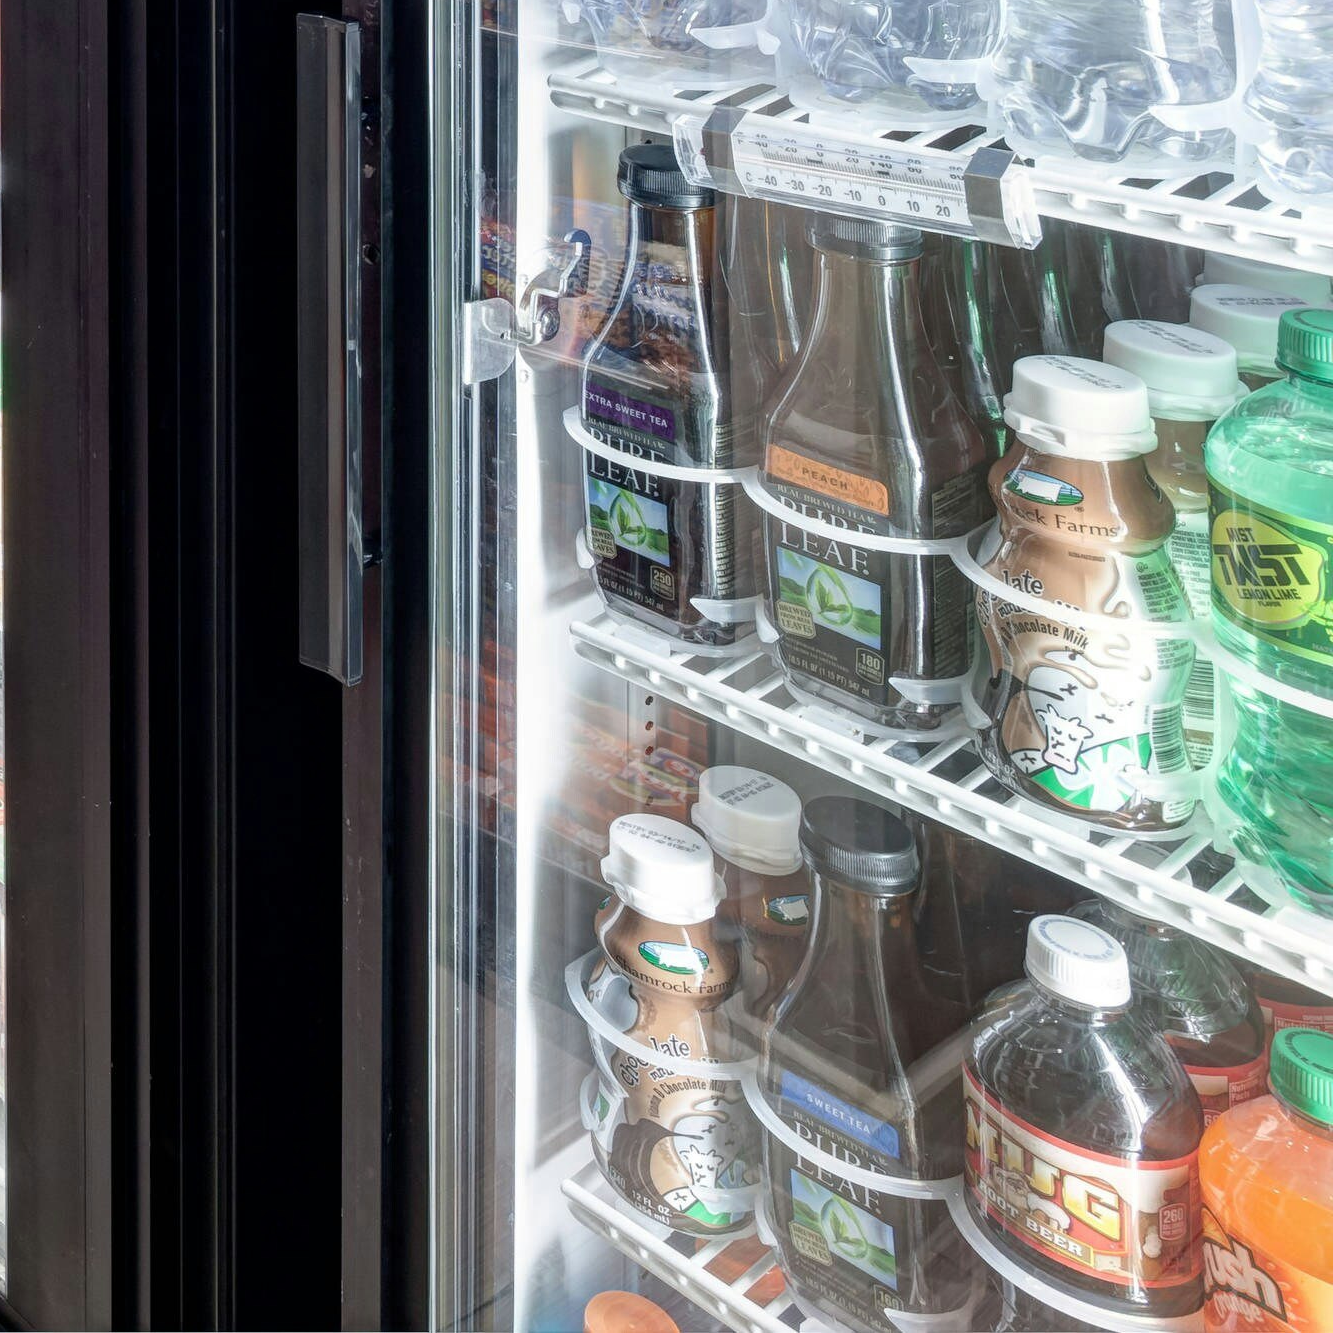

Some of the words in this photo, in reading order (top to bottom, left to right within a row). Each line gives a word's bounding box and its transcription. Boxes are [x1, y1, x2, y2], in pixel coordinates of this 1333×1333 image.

[758, 175, 777, 186] -40
[785, 179, 805, 192] -30
[812, 184, 832, 197] -20
[843, 189, 862, 202] -10
[878, 195, 886, 206] 0
[907, 199, 920, 213] 10
[935, 204, 951, 218] 20
[583, 392, 612, 408] EXTRA
[615, 403, 647, 421] SWEET
[649, 415, 668, 428] TEA
[802, 467, 848, 491] PEACH
[777, 484, 800, 499] REAL
[1054, 513, 1119, 537] Farms
[1226, 527, 1255, 544] MIST
[781, 521, 869, 573] LEAF
[653, 570, 672, 585] 250
[1237, 587, 1271, 600] LEMON
[1271, 588, 1301, 601] LIME
[781, 619, 813, 634] LEAVES
[1062, 629, 1090, 650] Milk
[860, 652, 881, 671] 180
[615, 954, 694, 995] Shamrock
[661, 1080, 707, 1096] Chocolate
[806, 1093, 845, 1120] SWEET
[849, 1117, 871, 1135] TEA
[979, 1180, 1020, 1217] ROOT
[1025, 1214, 1084, 1258] BEER
